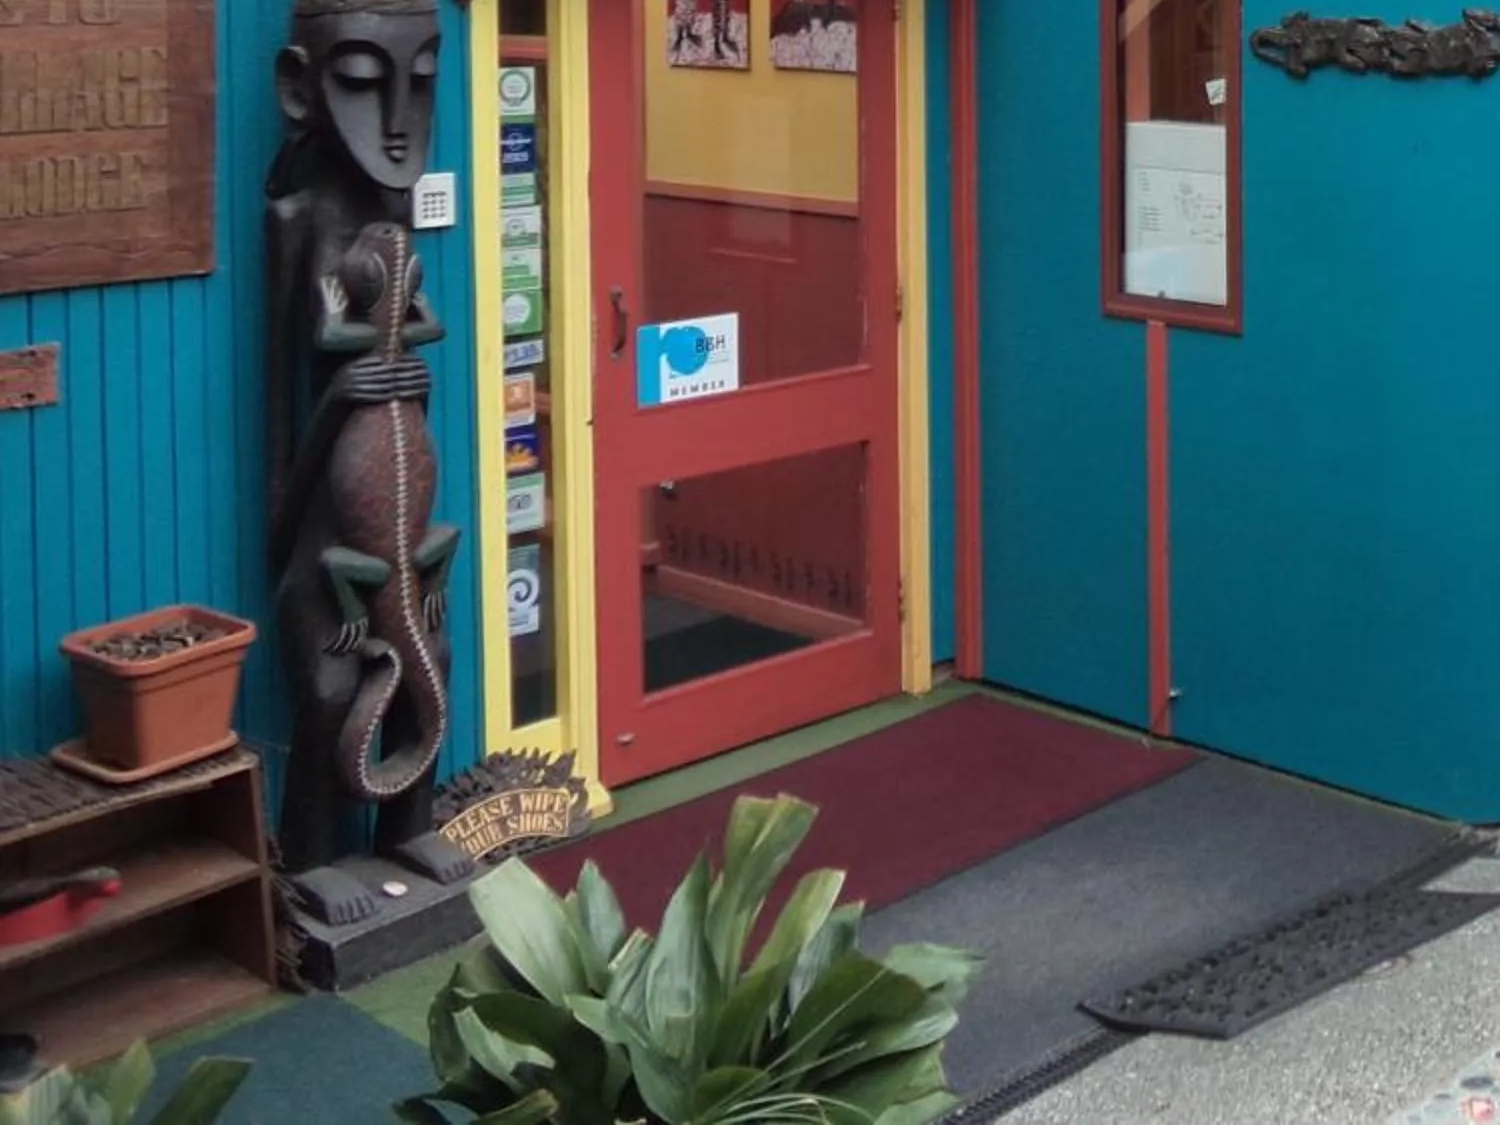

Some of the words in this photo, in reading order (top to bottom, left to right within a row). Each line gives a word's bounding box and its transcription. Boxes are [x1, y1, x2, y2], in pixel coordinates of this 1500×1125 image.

[669, 379, 725, 396] MEMBER
[445, 795, 513, 843] PLEASE
[520, 792, 567, 813] WIPE
[506, 813, 564, 835] SHOES
